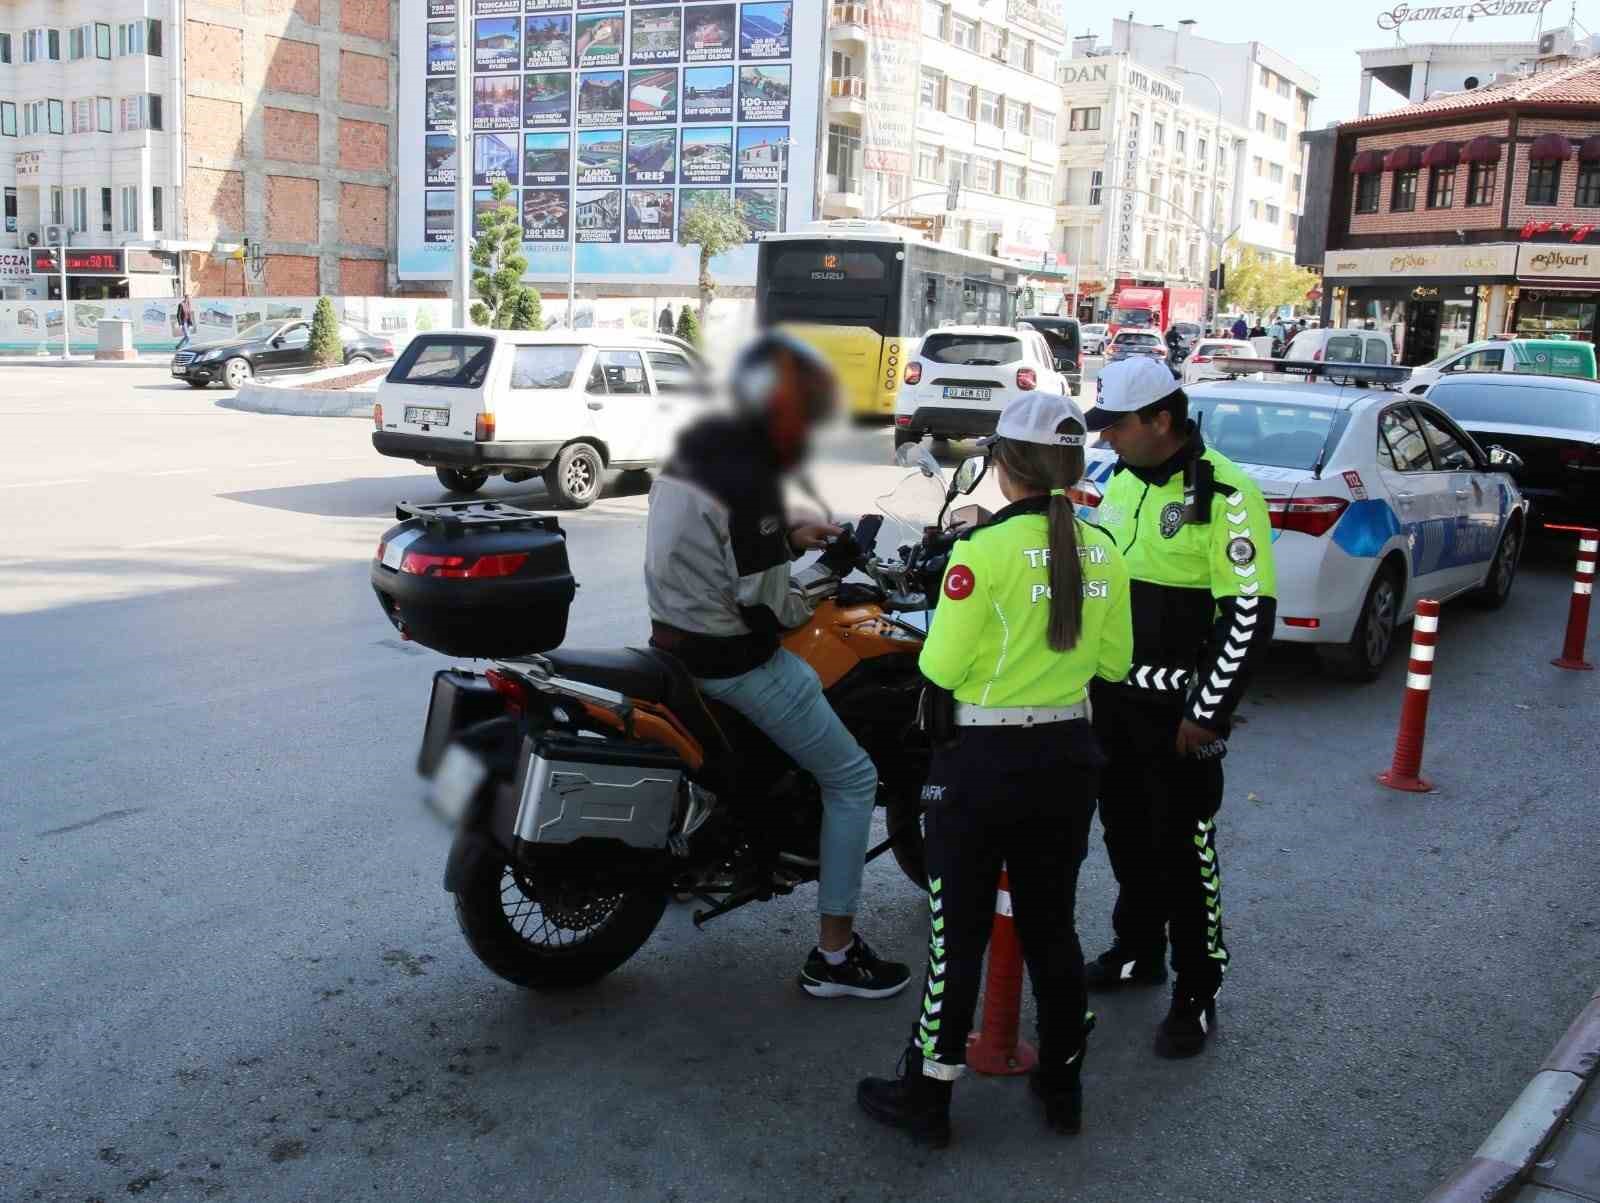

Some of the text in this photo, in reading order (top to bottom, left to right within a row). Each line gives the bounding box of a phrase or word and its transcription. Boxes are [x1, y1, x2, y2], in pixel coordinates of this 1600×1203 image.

[1058, 64, 1108, 83] DAN
[636, 170, 665, 183] KREŞ
[811, 271, 844, 280] ISUZU
[1023, 546, 1108, 568] TRFİK
